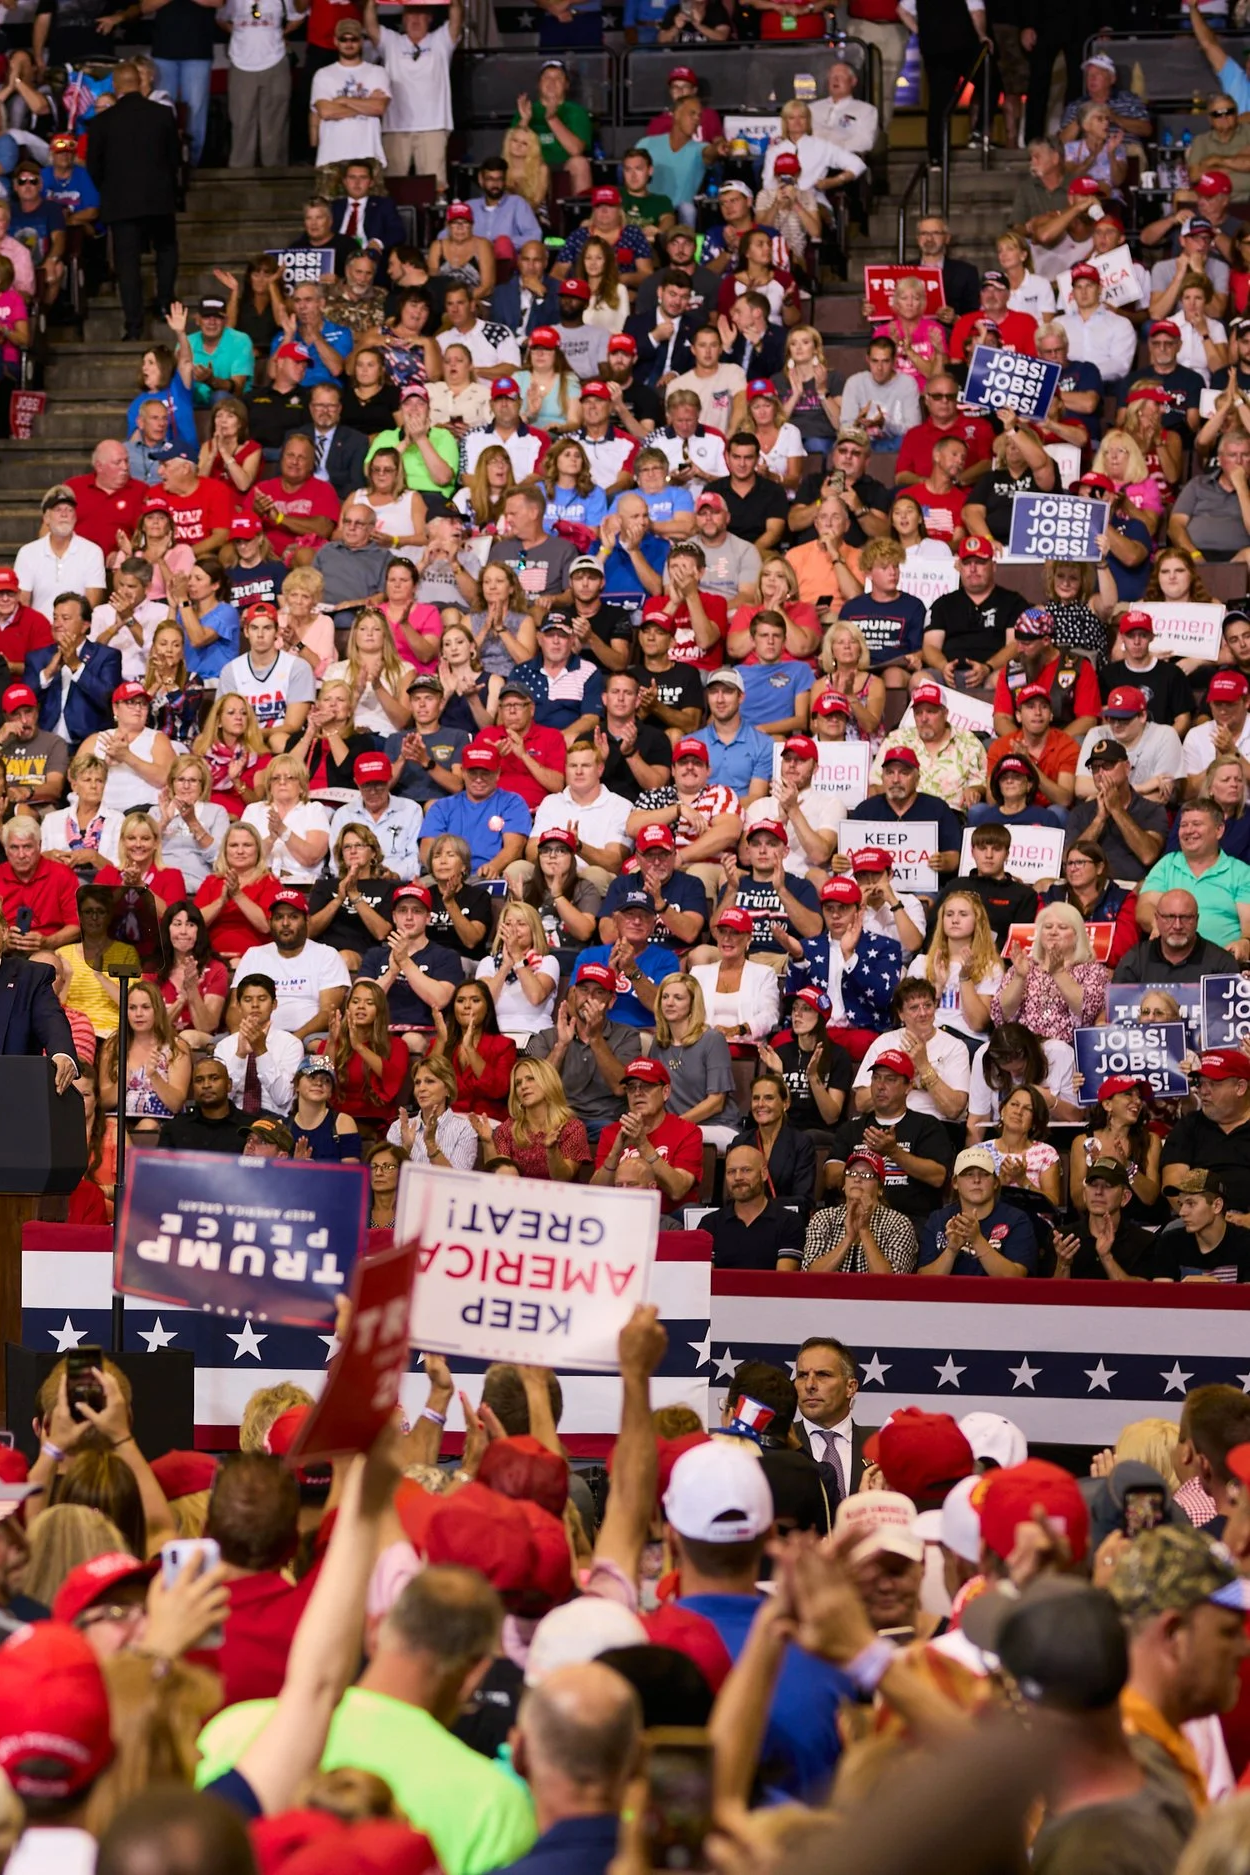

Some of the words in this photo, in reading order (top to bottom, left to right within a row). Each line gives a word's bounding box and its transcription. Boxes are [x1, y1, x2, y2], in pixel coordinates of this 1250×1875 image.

[282, 268, 322, 282] OBS!
[987, 352, 1047, 380] JOBS!
[982, 370, 1043, 399] JOBS!
[978, 388, 1039, 416] JOBS!
[546, 503, 586, 516] RUMP
[1028, 499, 1092, 520] JOBS!
[1026, 518, 1090, 538] JOBS!
[1024, 537, 1089, 557] JOBS!
[1153, 613, 1215, 635] omen
[1168, 633, 1206, 643] TRUMP
[948, 710, 996, 735] men
[814, 763, 860, 781] men
[814, 784, 852, 792] TRUMP
[864, 833, 908, 845] KEEP
[892, 868, 918, 880] AT!
[1093, 1028, 1167, 1052] JOBS!
[1095, 1050, 1168, 1074] JOBS!
[158, 1212, 330, 1249] PENCE
[446, 1199, 607, 1247] GREAT!
[136, 1233, 346, 1286] TRUMP
[417, 1242, 638, 1297] AMERICA
[461, 1296, 573, 1335] KEEP
